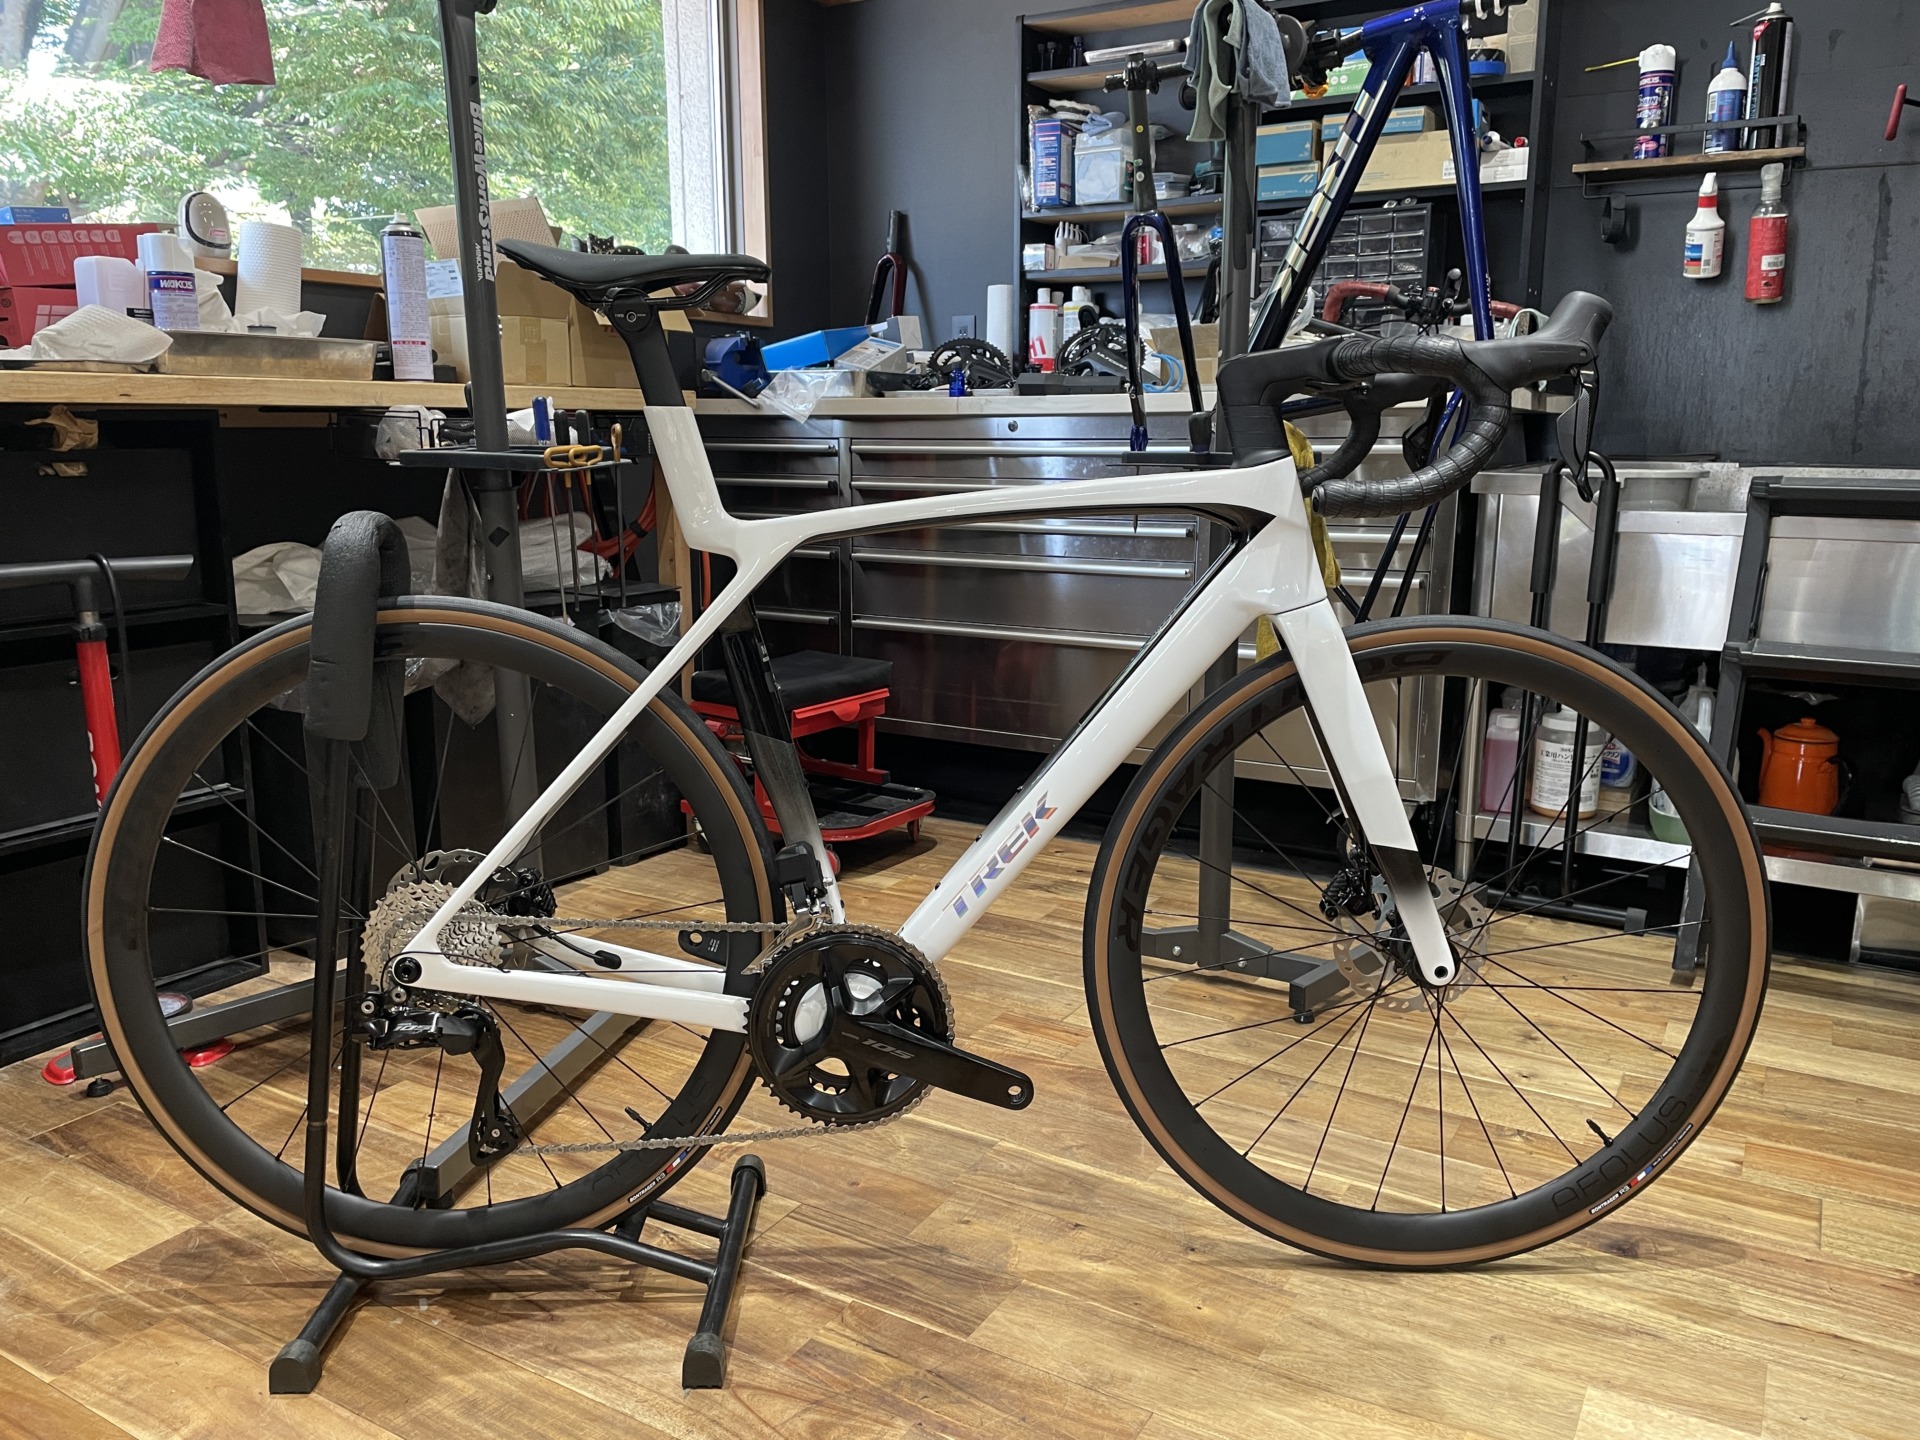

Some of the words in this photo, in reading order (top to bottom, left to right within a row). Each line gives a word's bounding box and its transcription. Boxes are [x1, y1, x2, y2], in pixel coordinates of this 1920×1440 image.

[469, 101, 495, 282] BikeWorkStand
[475, 242, 484, 282] MINOURA
[943, 790, 1058, 918] TREK
[862, 1039, 915, 1059] 105
[629, 1181, 656, 1203] BONTRAGER
[655, 1172, 666, 1182] R3
[1591, 1193, 1620, 1214] BONTRAGER
[1619, 1185, 1631, 1195] R3
